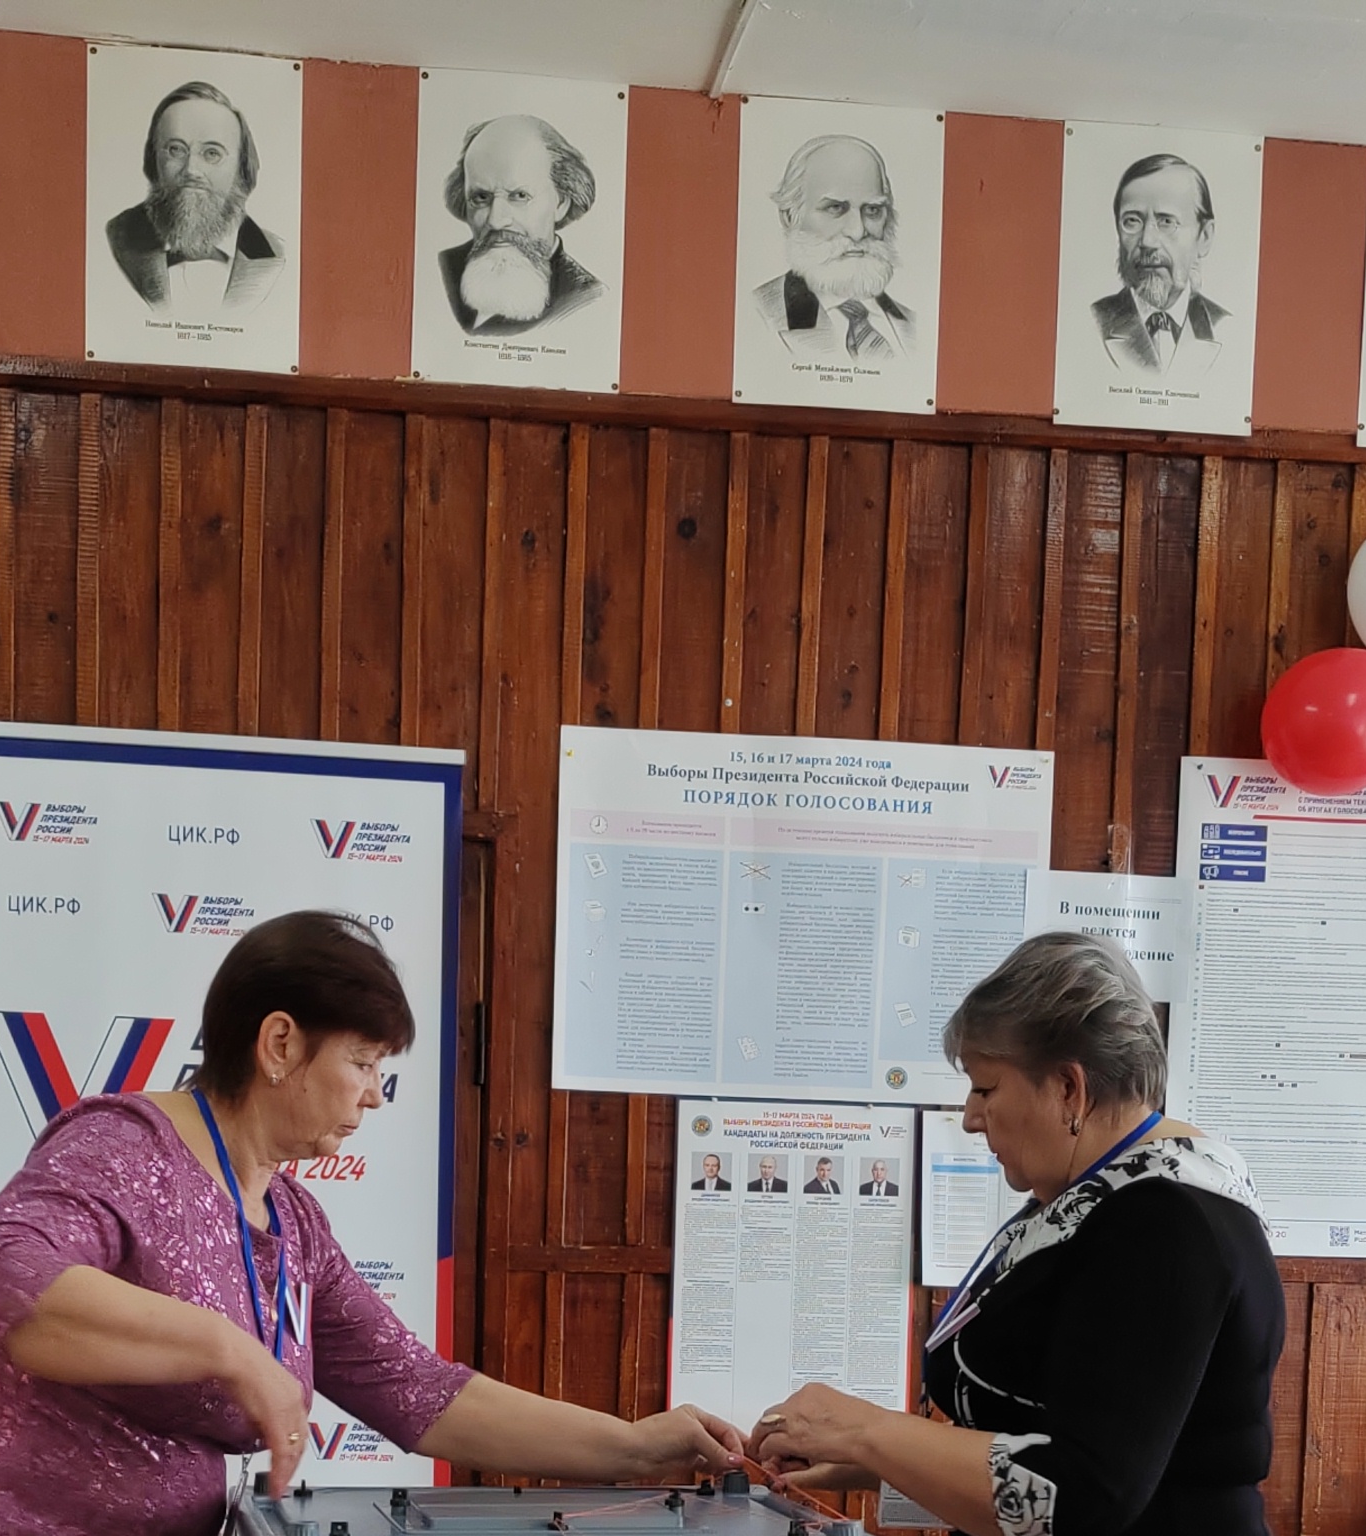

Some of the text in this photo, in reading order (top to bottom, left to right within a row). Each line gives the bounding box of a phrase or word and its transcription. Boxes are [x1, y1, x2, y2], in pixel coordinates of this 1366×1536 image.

[730, 751, 747, 764] 15,
[751, 752, 764, 763] 16
[779, 753, 792, 764] 17
[795, 757, 832, 768] марта
[835, 756, 862, 767] 2024
[865, 760, 892, 770] года
[647, 764, 969, 794] Выборы Президента Российской Федерации
[1244, 776, 1278, 784] ВЫБОРЫ
[1240, 785, 1287, 794] ПРЕЗИДЕНТА
[683, 789, 933, 814] ПОРЯДОК ГОЛОСОВАНИЯ
[1236, 794, 1267, 802] РОССИИ
[1303, 797, 1352, 805] ПРИМЕНЕНИЕМ
[45, 803, 86, 813] ВЫБОРЫ
[40, 814, 98, 825] ПРЕЗИДЕНТА
[35, 825, 74, 834] РОССИИ
[360, 822, 400, 832] ВЫБОРЫ
[51, 836, 73, 844] МАРТА
[168, 825, 240, 845] ЦИК.РФ
[355, 833, 411, 844] ПРЕЗИДЕНТА
[351, 843, 387, 852] РОССИИ
[366, 854, 387, 862] МАРТА
[8, 895, 81, 916] ЦИК.РФ
[203, 896, 243, 906] ВЫБОРЫ
[198, 906, 255, 917] ПРЕЗИДЕНТА
[1059, 901, 1160, 920] В помещении
[193, 917, 231, 926] РОССИИ
[208, 928, 230, 936] МАРТА
[1081, 926, 1137, 939] ведется
[779, 1112, 799, 1120] МАРТА
[816, 1113, 833, 1121] ГОДА
[723, 1118, 871, 1130] ВЫБОРЫ ПРЕЗИДЕНТА РОССИЙСКОЙ ФЕДЕРАЦИИ
[723, 1129, 767, 1138] КАНДИДАТЫ
[780, 1131, 824, 1140] ДОЛЖНОСТЬ
[826, 1133, 871, 1142] ПРЕЗИДЕНТА
[750, 1140, 844, 1151] РОССИЙСКОЙ ФЕДЕРАЦИИ
[303, 1153, 367, 1181] 2024
[354, 1261, 394, 1270] ВЫБОРЫ
[356, 1271, 405, 1281] РЕЗИДЕНТА
[342, 1443, 378, 1452] РОССИИ
[379, 1454, 395, 1462] 2024
